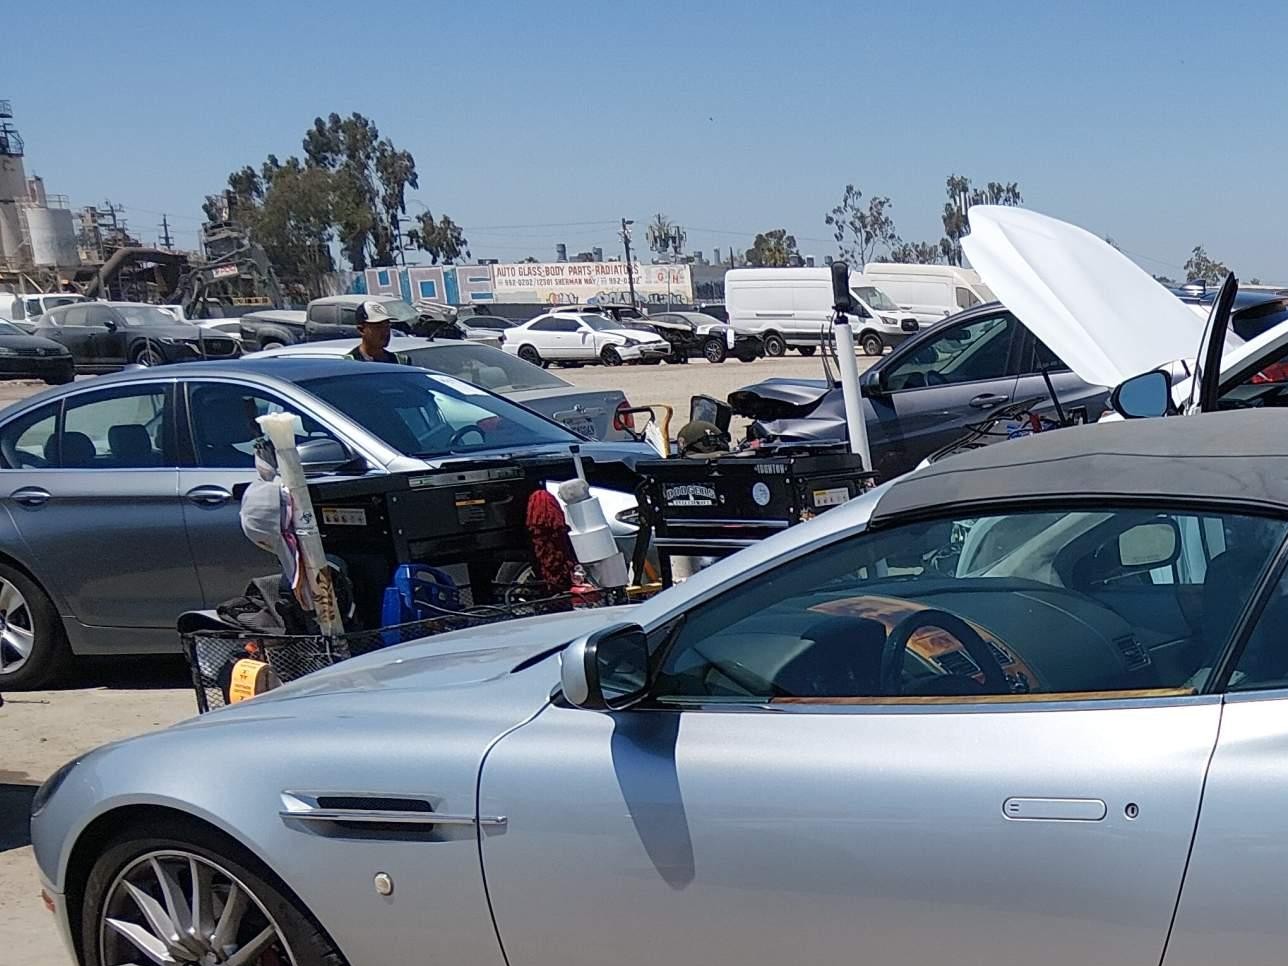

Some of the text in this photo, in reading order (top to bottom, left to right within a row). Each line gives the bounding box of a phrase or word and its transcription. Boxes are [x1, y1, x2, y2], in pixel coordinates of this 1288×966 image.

[496, 266, 516, 277] AUTO
[568, 264, 639, 276] PARTS-RADIATOS
[554, 277, 583, 286] SHERMAN
[665, 484, 718, 501] DODGERS
